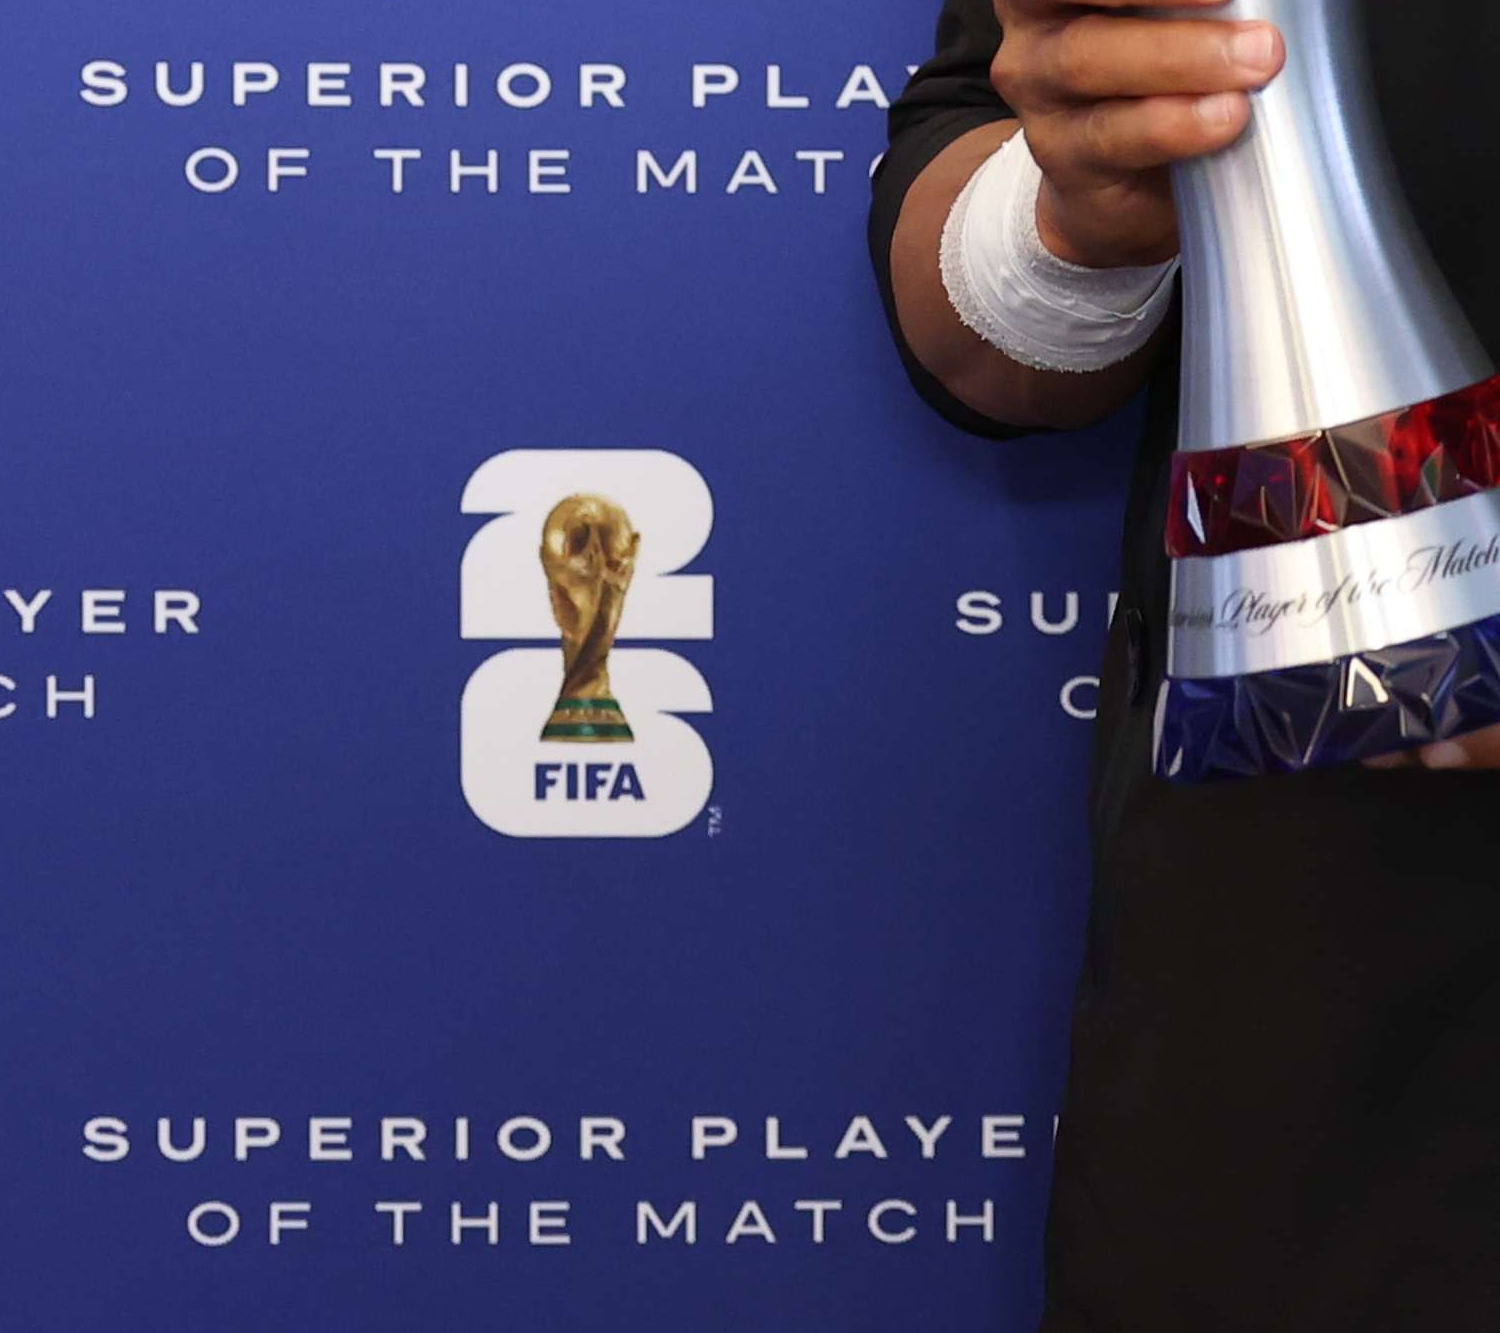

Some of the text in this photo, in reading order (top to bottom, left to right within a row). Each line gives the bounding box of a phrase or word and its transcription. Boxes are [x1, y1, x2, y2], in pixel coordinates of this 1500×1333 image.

[80, 60, 922, 109] SUPERIOR PLA
[185, 147, 886, 194] OF THE MAT
[1214, 588, 1310, 634] Player
[1308, 575, 1351, 627] of
[1400, 533, 1500, 592] Match
[534, 762, 646, 801] FIFA
[82, 1115, 1060, 1162] SUPERIOR PLAYE
[187, 1199, 994, 1247] OF THE MATCH
